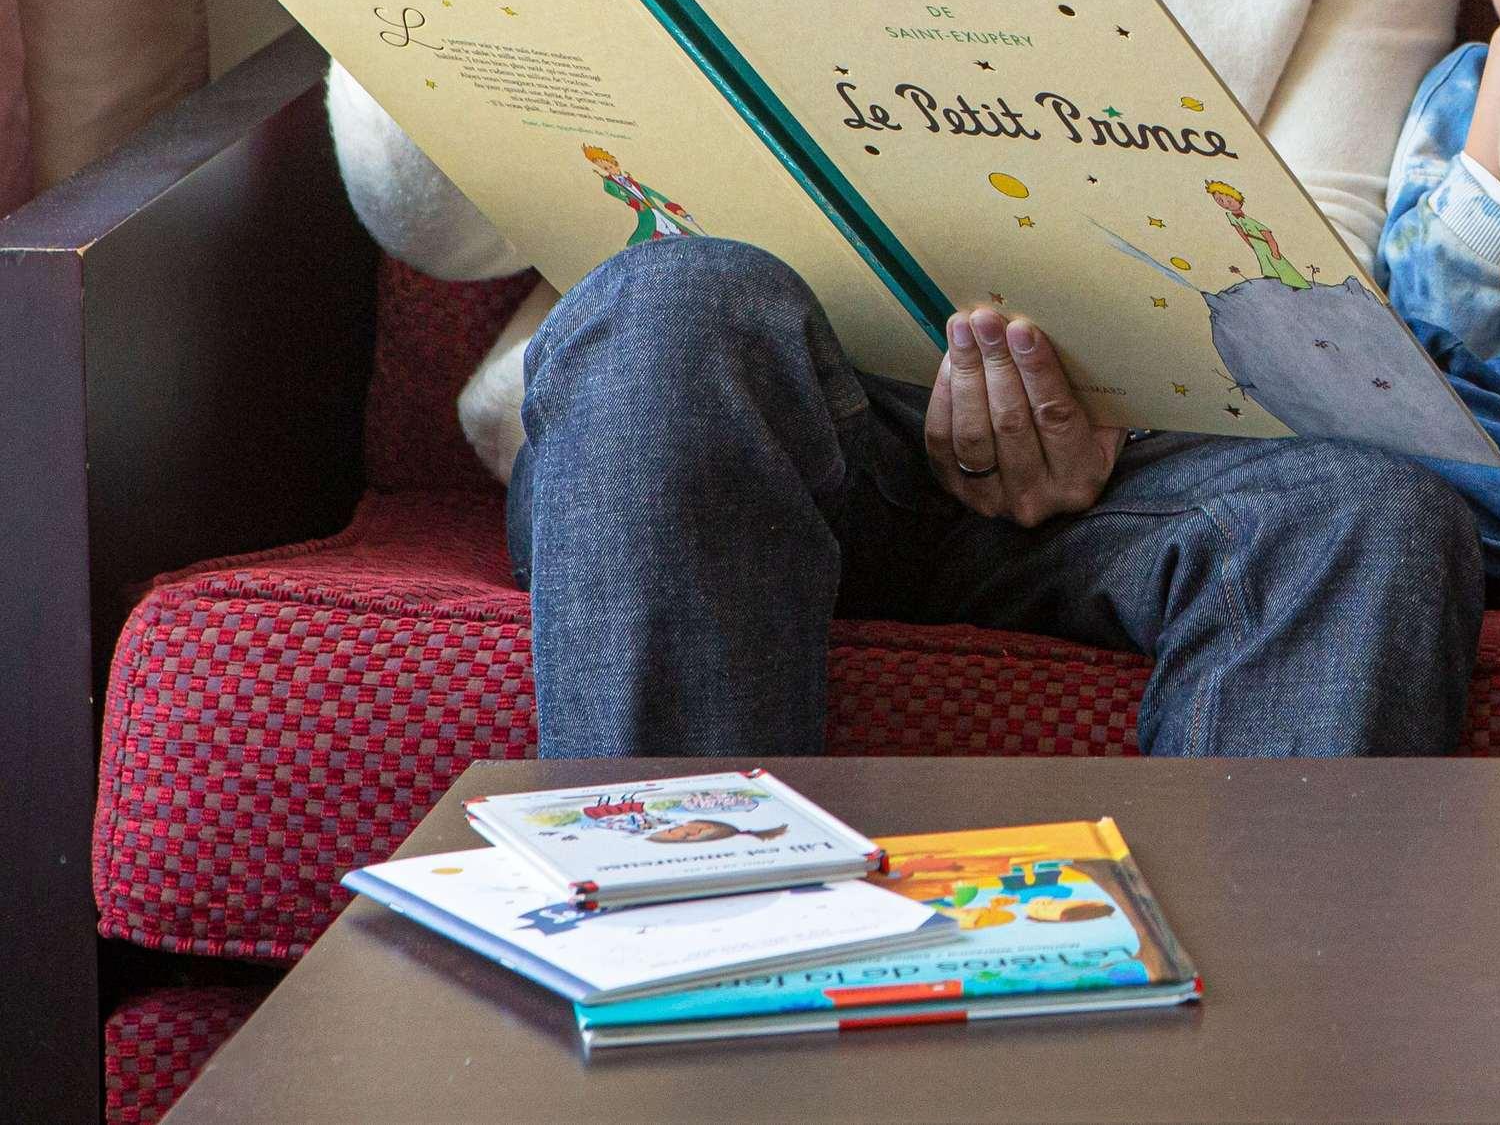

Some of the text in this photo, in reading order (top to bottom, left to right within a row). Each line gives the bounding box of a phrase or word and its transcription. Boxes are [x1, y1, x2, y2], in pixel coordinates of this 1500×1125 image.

[926, 4, 955, 19] DE
[884, 25, 1034, 48] SAINT-EXUPÉRY
[836, 81, 1240, 160] Le Petit Prince
[804, 972, 845, 984] la
[862, 966, 920, 978] de
